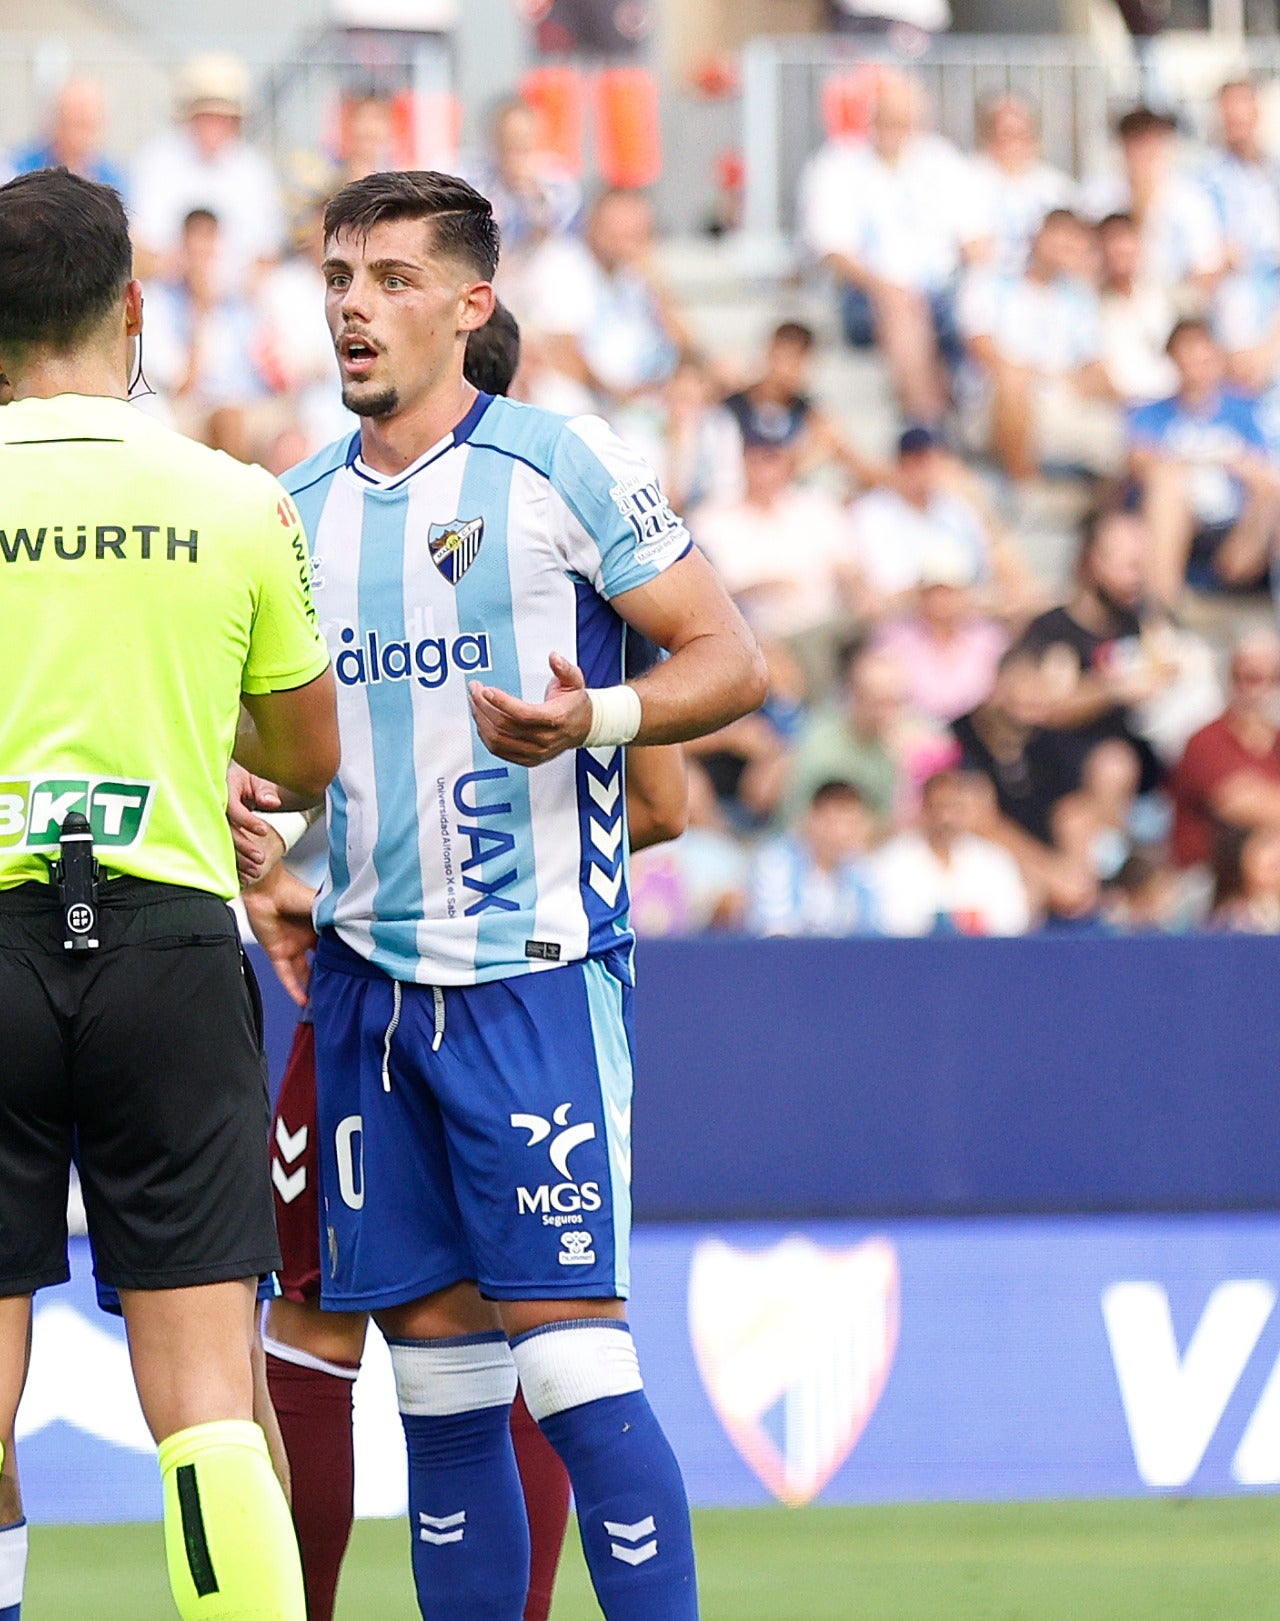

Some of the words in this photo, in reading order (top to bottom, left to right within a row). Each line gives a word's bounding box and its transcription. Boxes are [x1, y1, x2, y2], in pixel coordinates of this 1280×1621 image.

[336, 626, 489, 689] álaga
[436, 777, 449, 836] Universidad
[442, 837, 453, 876] Alfonso
[453, 767, 520, 917] UAX
[446, 876, 456, 885] X
[516, 1182, 602, 1215] MGS
[542, 1214, 583, 1227] Seguros
